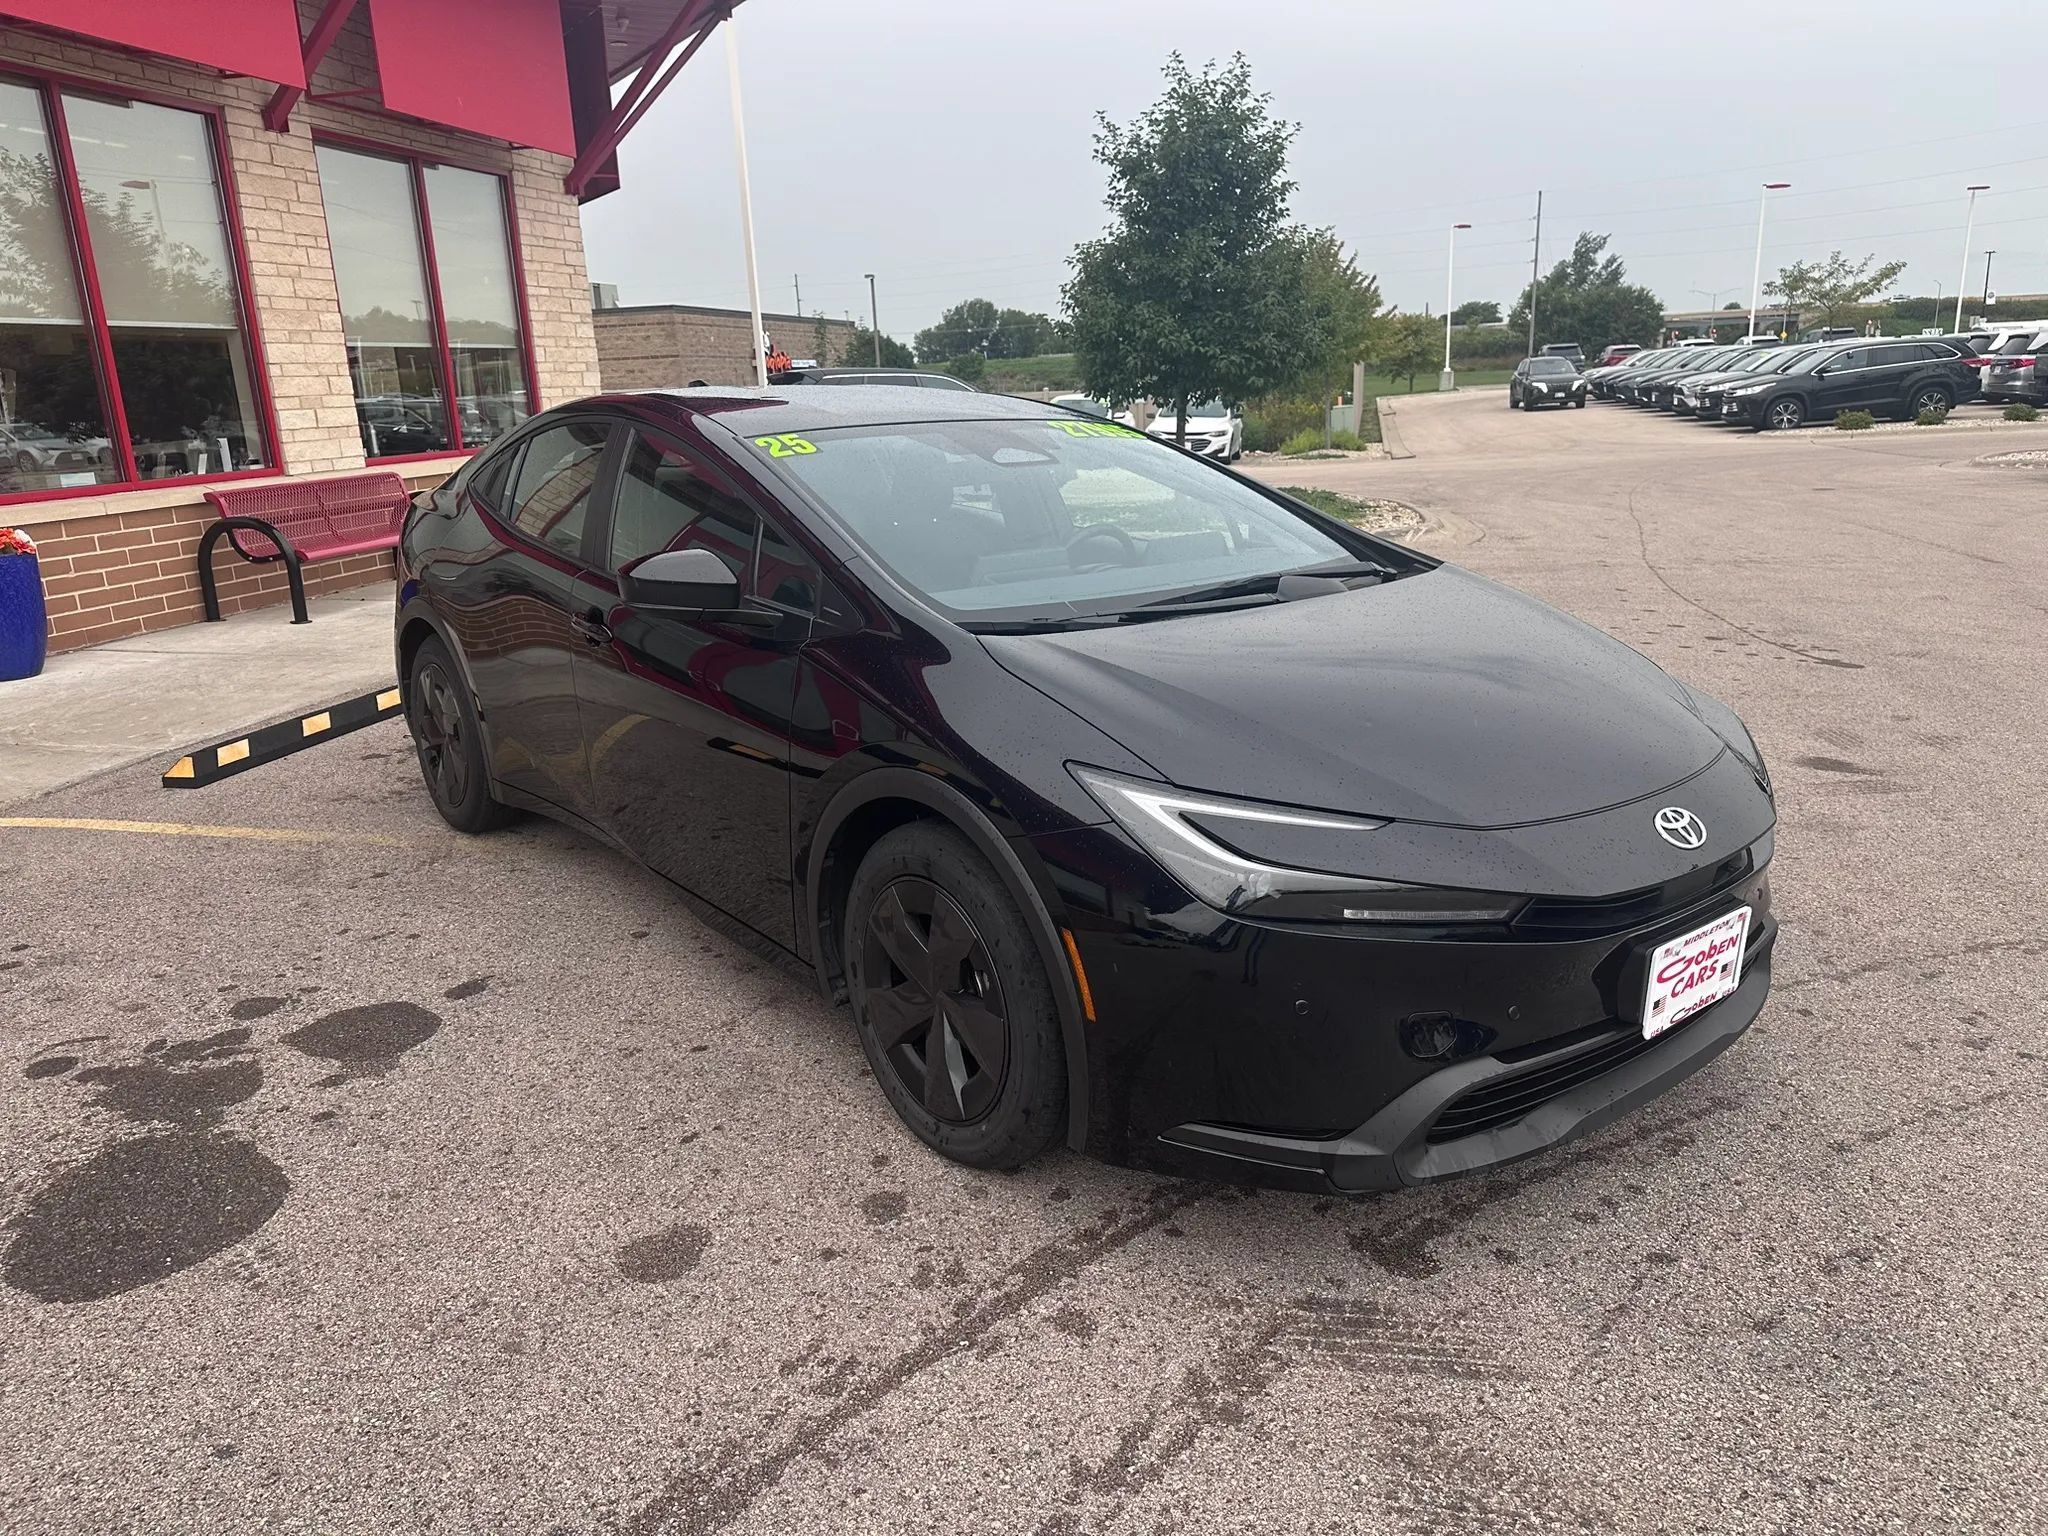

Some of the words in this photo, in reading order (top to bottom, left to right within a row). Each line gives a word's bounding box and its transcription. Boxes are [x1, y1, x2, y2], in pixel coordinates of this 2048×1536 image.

[754, 433, 817, 458] 25
[1683, 919, 1731, 947] MIDDLETON
[1670, 959, 1718, 998] CARS
